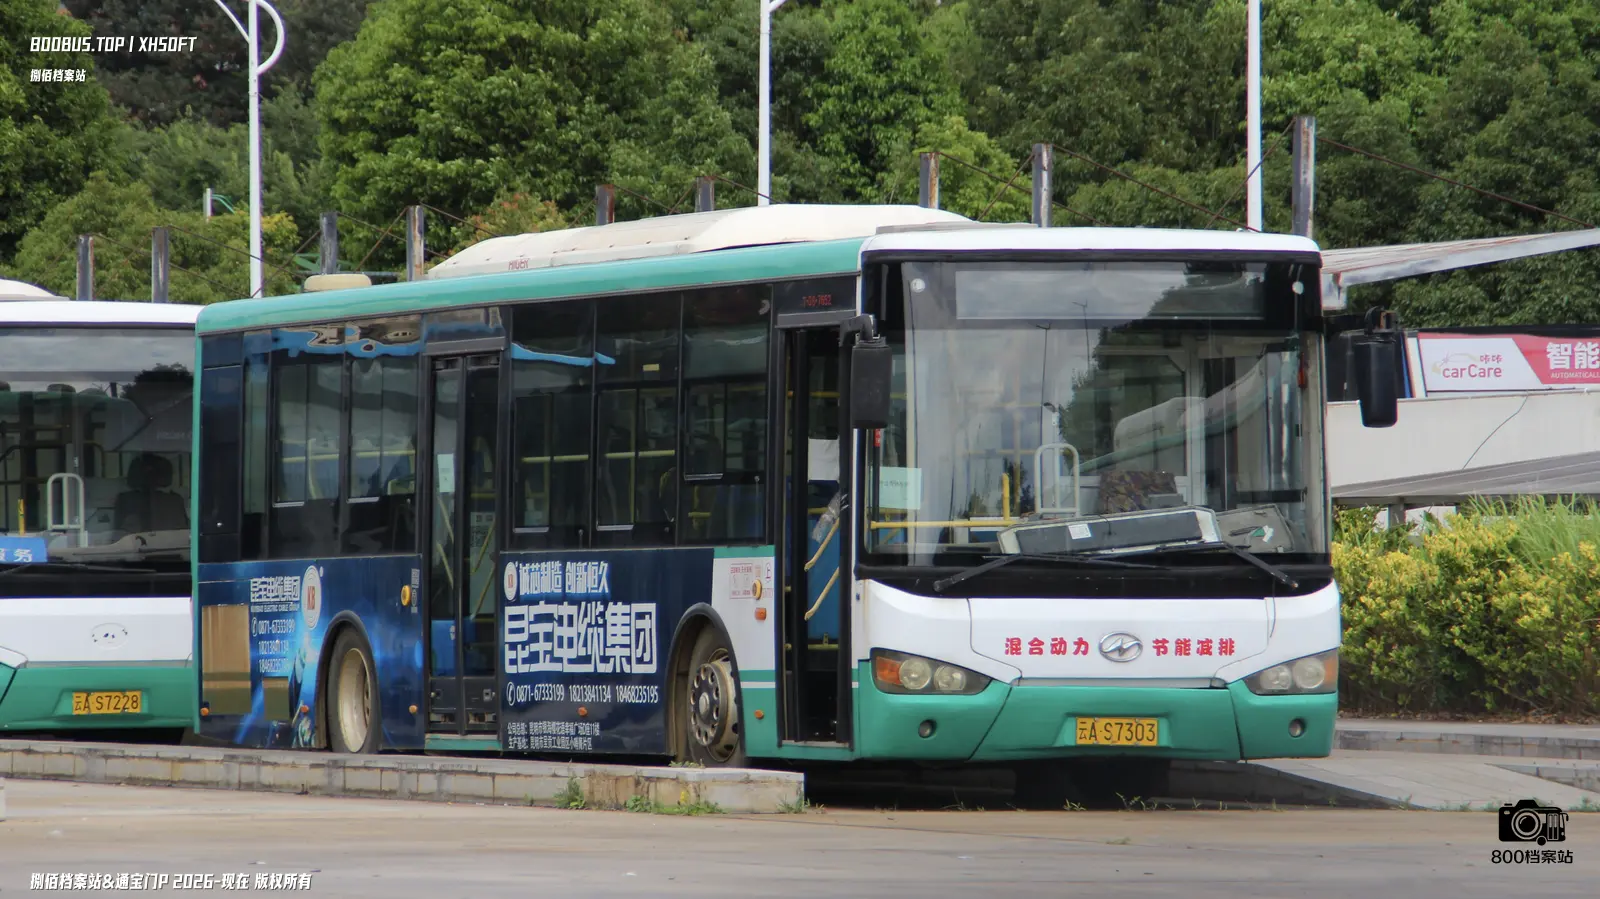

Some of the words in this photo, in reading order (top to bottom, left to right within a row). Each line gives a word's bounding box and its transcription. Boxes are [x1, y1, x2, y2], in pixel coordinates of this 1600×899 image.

[1546, 342, 1600, 370] 智能
[250, 576, 300, 602] 昆宝电缆集团
[565, 561, 609, 594] 创新恒久
[504, 601, 657, 674] 昆宝电缆集团
[1004, 637, 1090, 656] 混合动力
[1152, 638, 1235, 656] 节能减排
[516, 684, 564, 703] 0871-67333199
[569, 685, 611, 703] 18213841134
[615, 685, 658, 704] 18468235195
